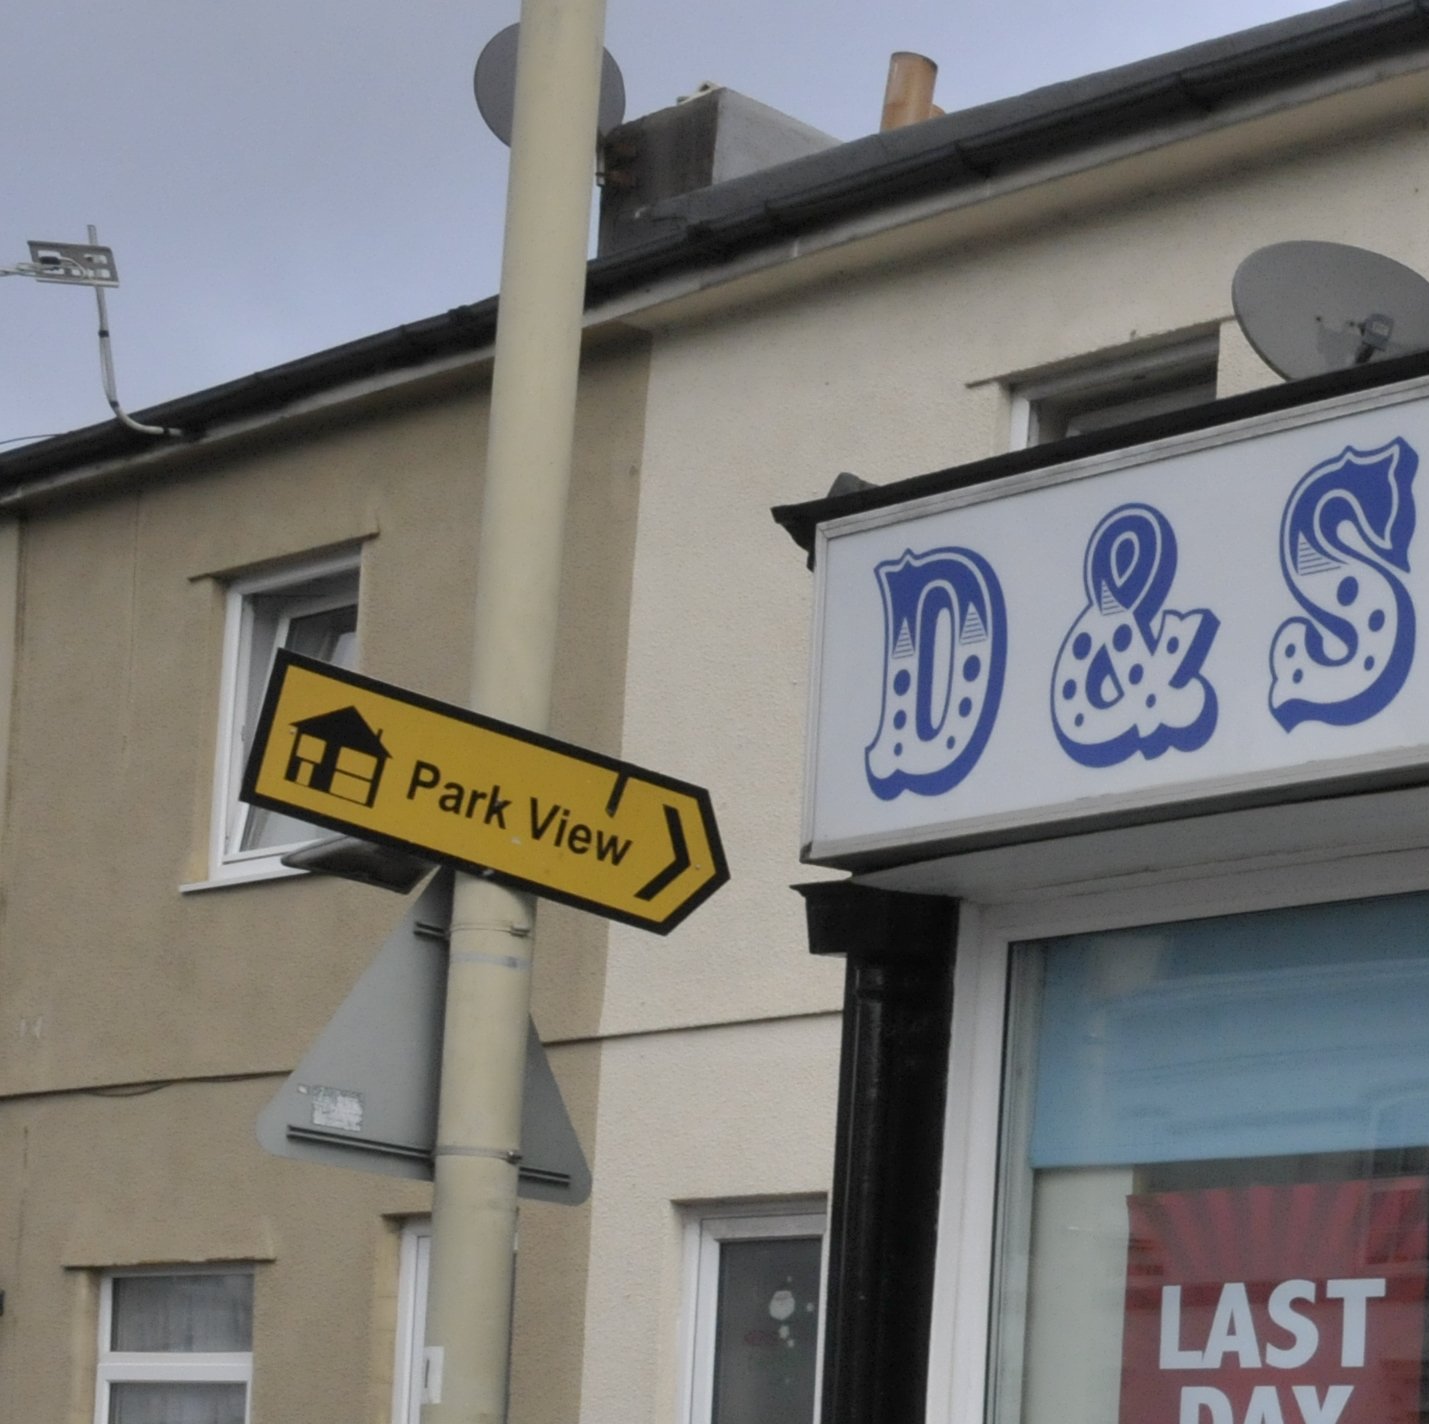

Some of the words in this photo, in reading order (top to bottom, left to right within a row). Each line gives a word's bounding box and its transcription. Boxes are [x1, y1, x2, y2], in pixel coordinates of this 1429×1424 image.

[865, 546, 1007, 800] D
[1051, 502, 1220, 768] &
[1269, 437, 1419, 732] S
[407, 760, 512, 829] Park
[530, 797, 633, 866] View
[1159, 1278, 1386, 1369] LAST
